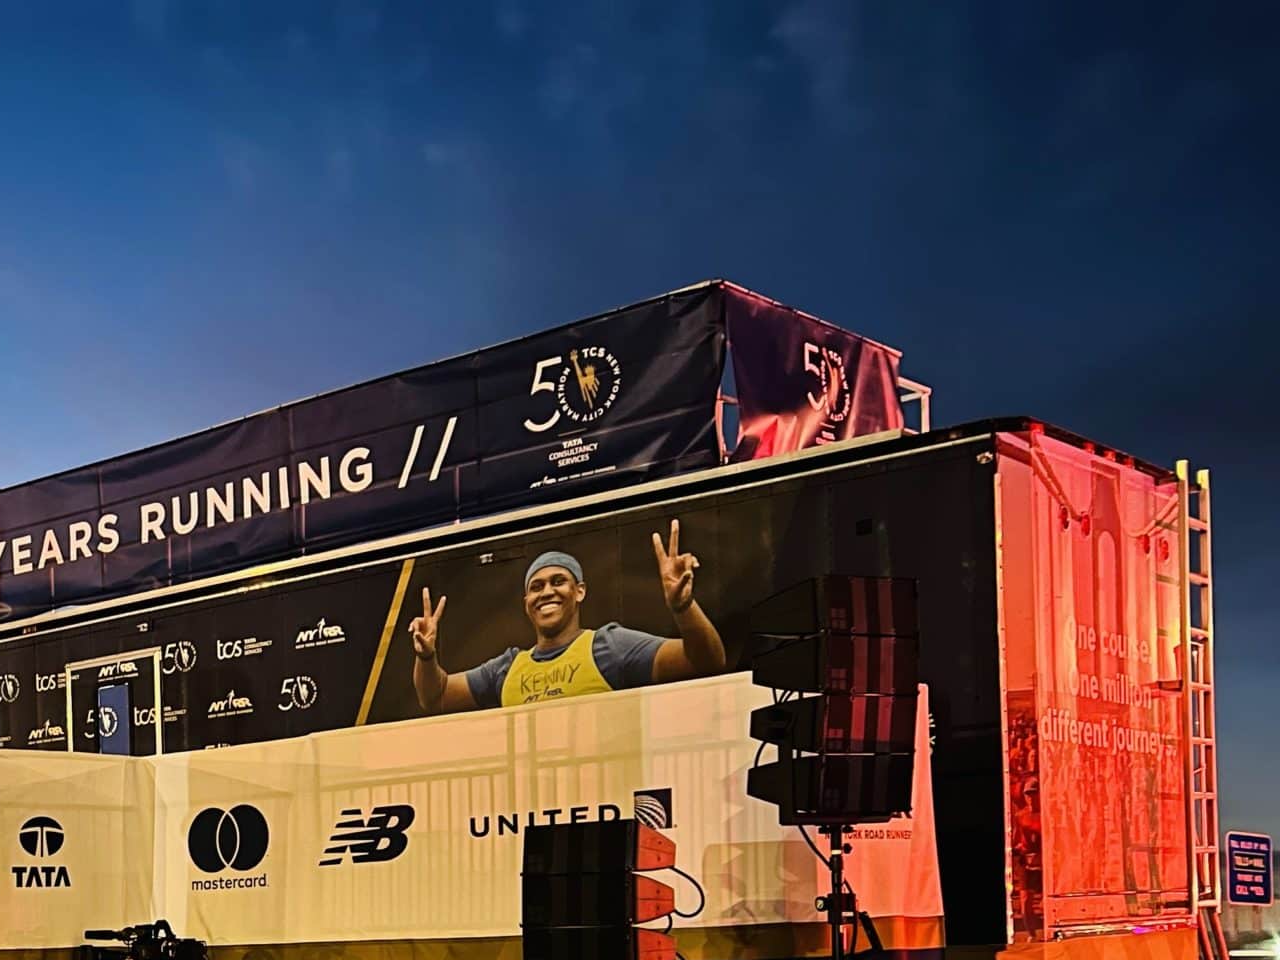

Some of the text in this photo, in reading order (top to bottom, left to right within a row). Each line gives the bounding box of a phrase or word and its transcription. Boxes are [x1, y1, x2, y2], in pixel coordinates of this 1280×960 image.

[562, 437, 583, 449] TATA
[139, 446, 373, 545] RUNNING
[216, 639, 242, 660] tcs
[35, 673, 57, 692] tcs
[520, 663, 581, 694] KENNY
[1102, 672, 1153, 710] million
[1040, 707, 1110, 749] different
[469, 804, 622, 838] UNITED
[864, 829, 885, 840] ROAD
[11, 866, 72, 888] TATA
[191, 873, 267, 891] mastercard
